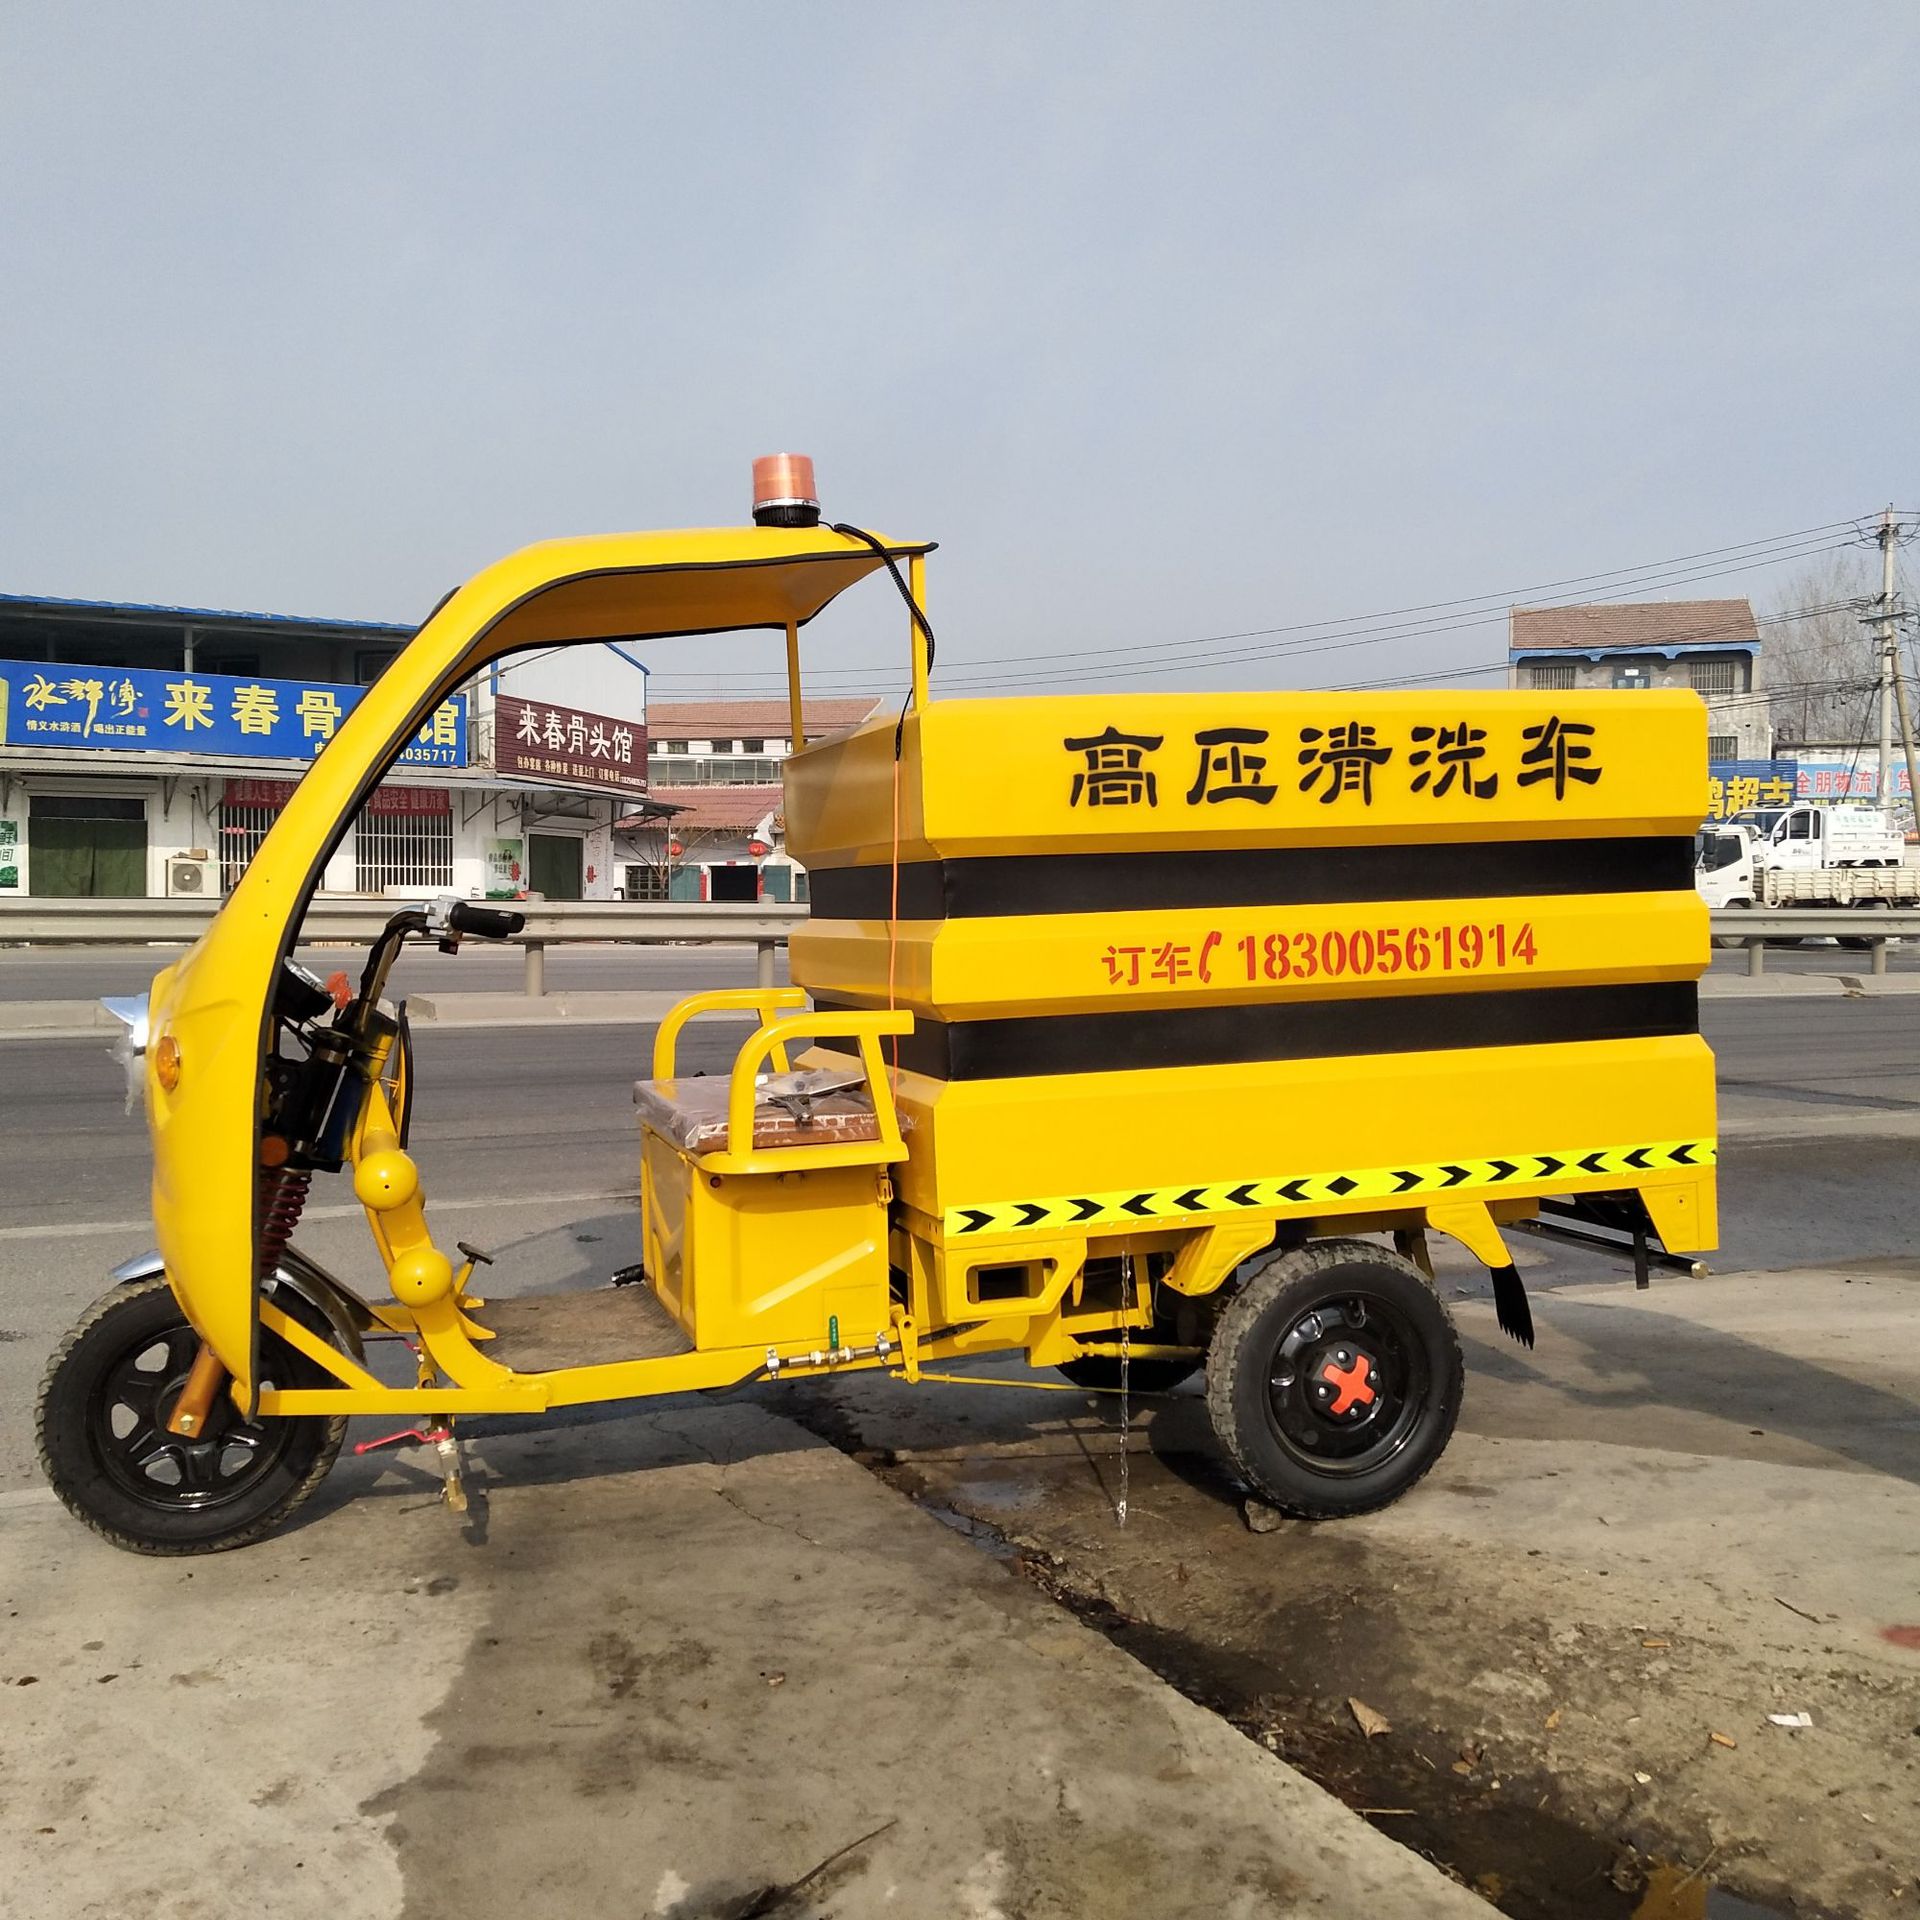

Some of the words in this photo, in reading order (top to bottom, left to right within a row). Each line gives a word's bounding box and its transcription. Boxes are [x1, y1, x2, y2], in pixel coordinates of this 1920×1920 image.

[93, 723, 147, 737] 喝出正能量
[163, 679, 459, 746] 来春骨馆
[516, 703, 633, 764] 来春骨头馆
[1064, 716, 1603, 807] 高压清洗车
[1101, 941, 1192, 986] 订车
[1238, 922, 1538, 981] 18300561914
